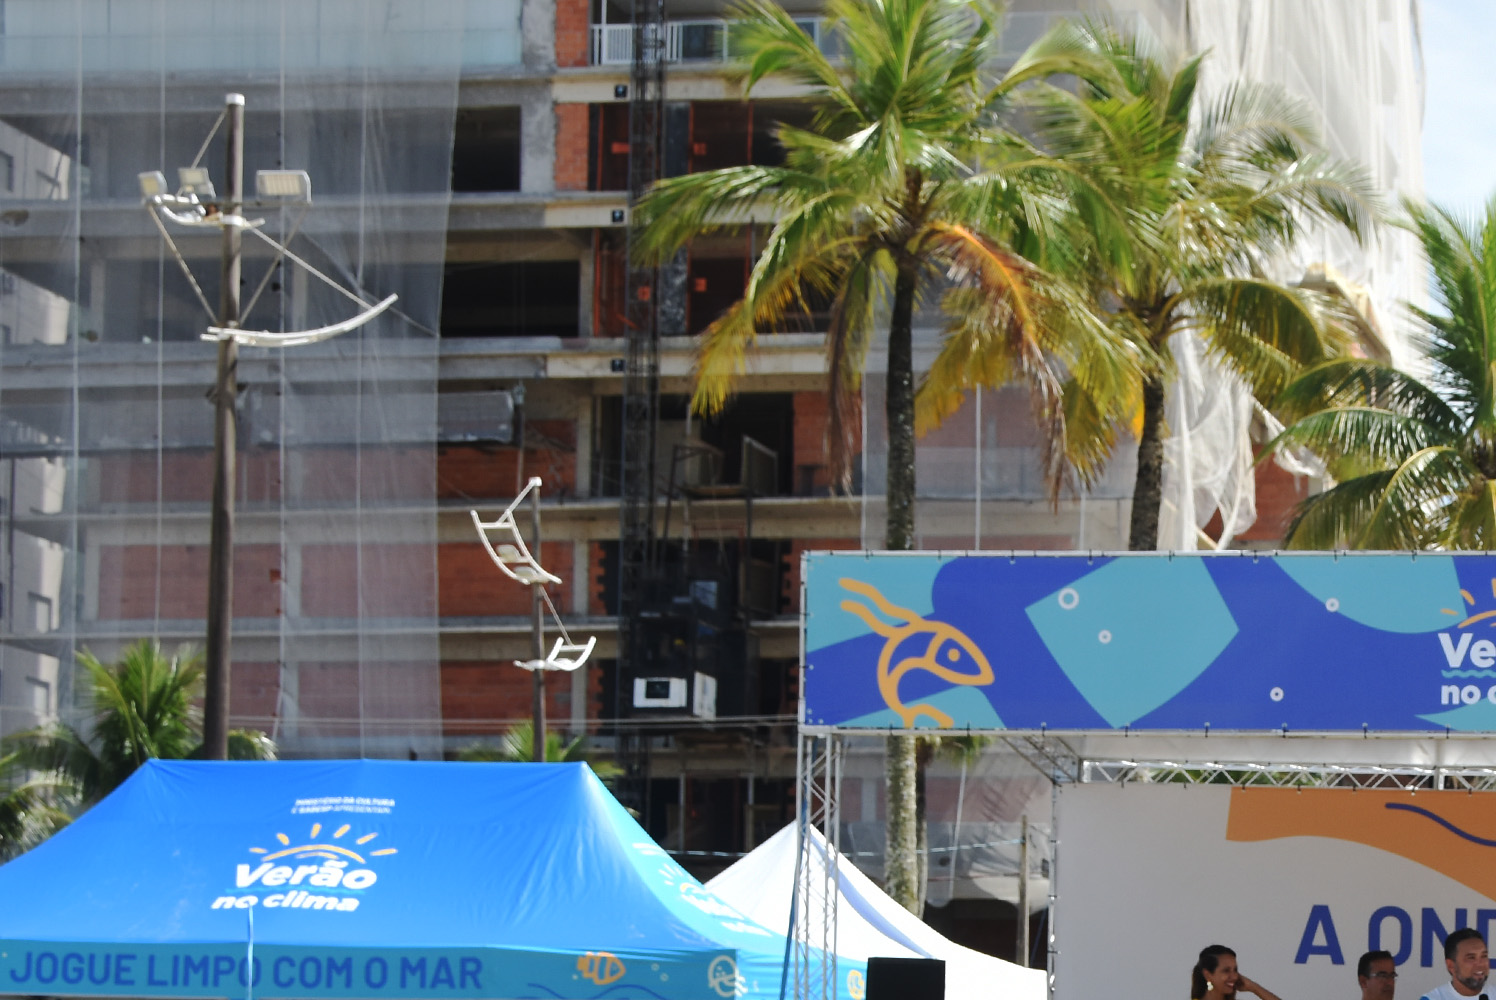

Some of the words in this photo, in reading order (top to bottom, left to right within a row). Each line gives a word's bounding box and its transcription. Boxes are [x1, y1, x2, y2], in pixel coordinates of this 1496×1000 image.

[1440, 684, 1482, 705] no
[236, 859, 378, 890] Verão
[211, 895, 259, 910] no
[262, 890, 360, 912] clima
[1294, 904, 1345, 966] A
[9, 951, 137, 985] JOGUE
[146, 953, 262, 989] LIMPO
[271, 955, 353, 989] COM
[364, 955, 389, 990] O
[401, 955, 484, 989] MAR
